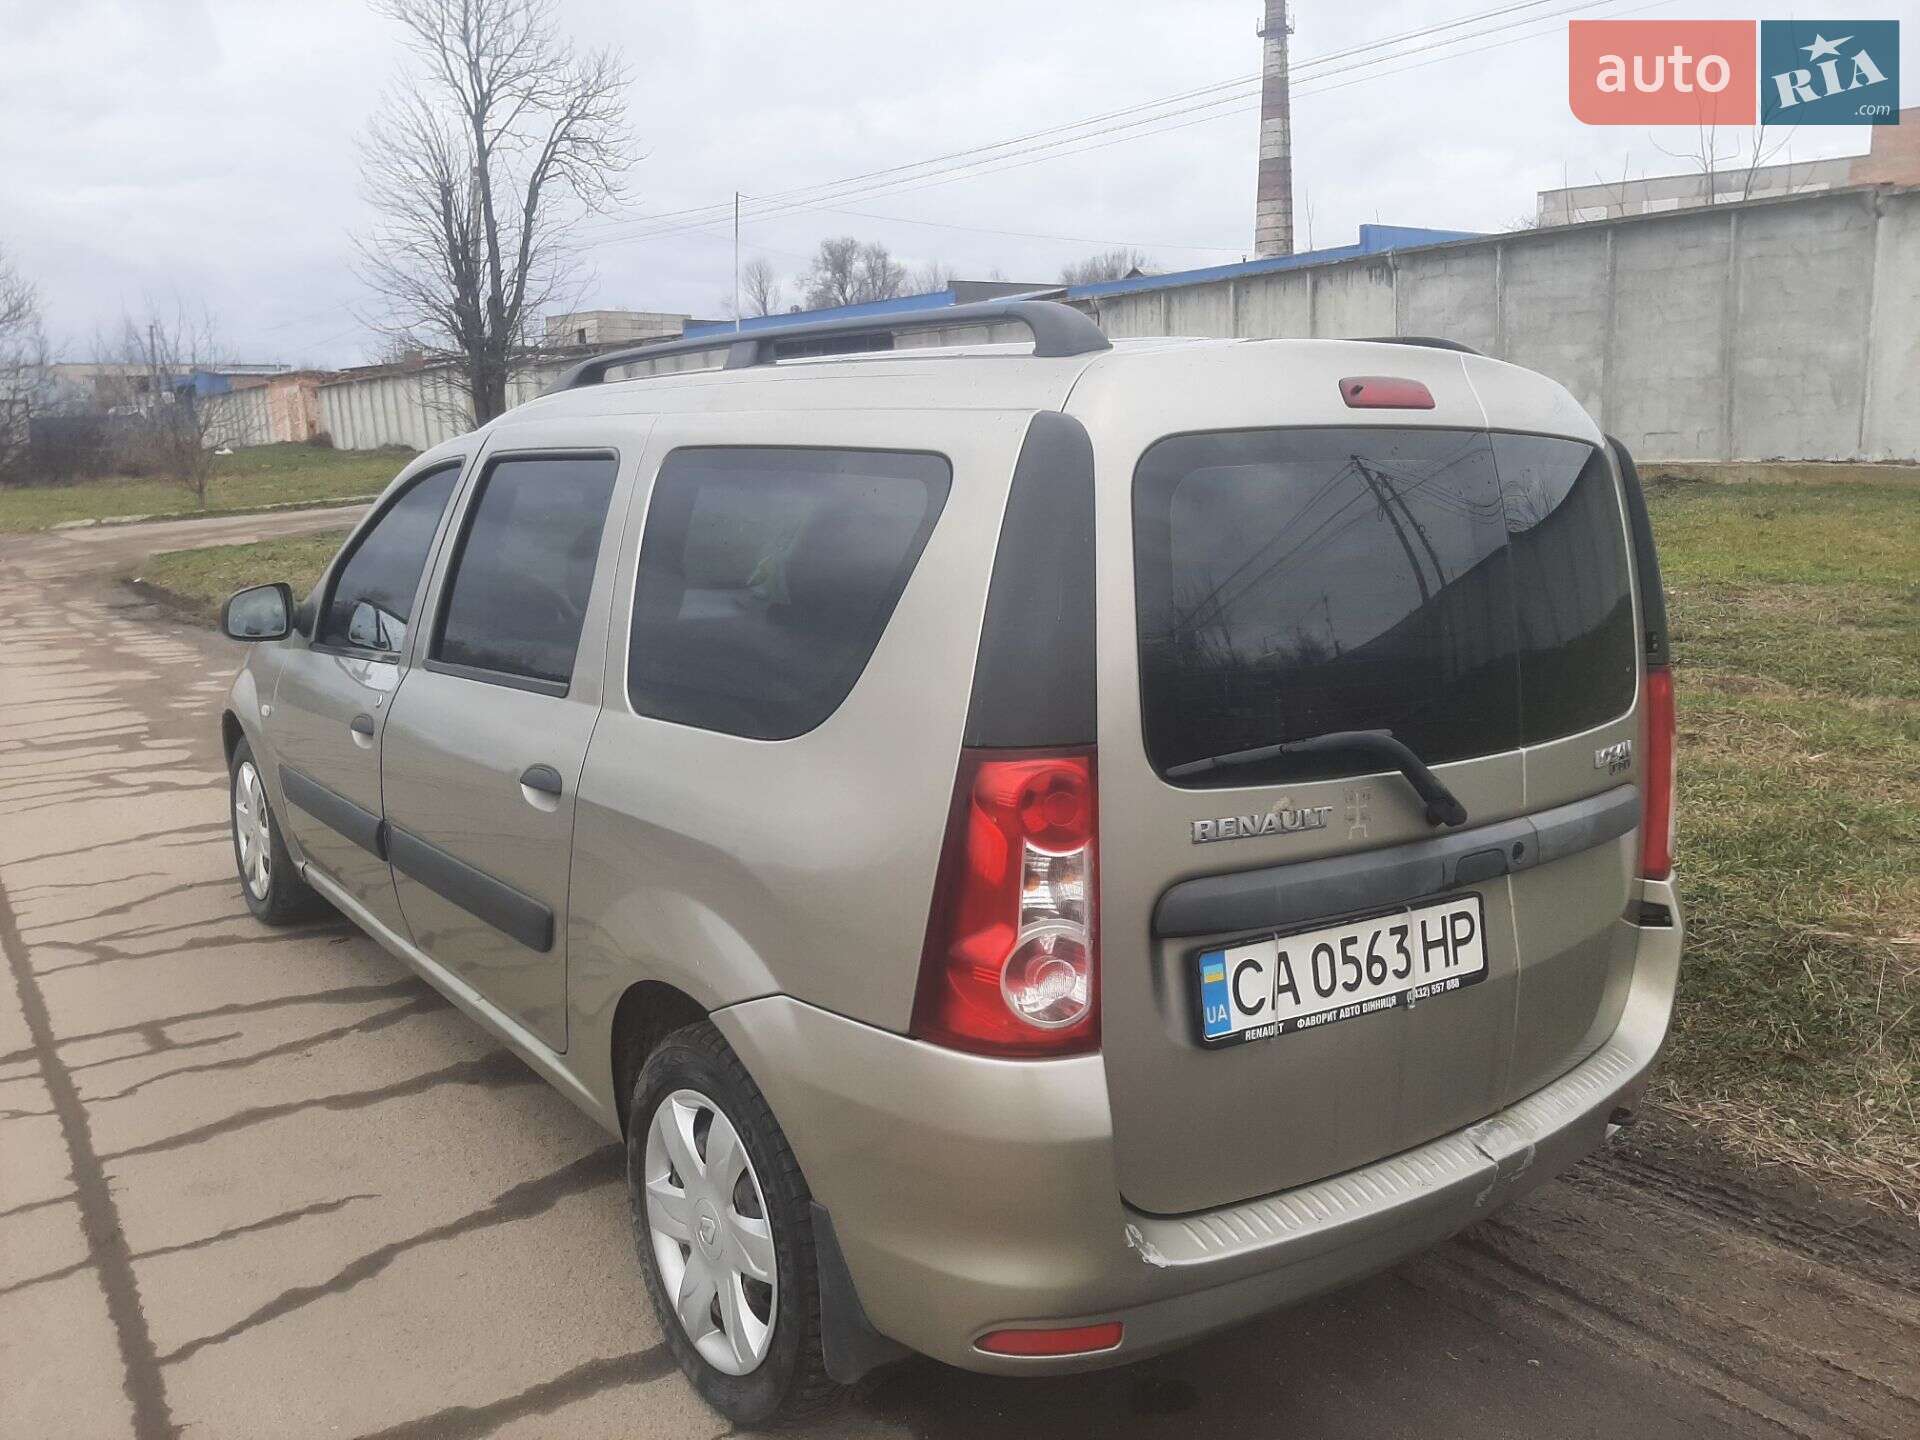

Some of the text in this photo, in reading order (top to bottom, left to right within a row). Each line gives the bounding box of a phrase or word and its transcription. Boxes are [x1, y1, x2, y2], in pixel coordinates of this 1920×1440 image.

[1192, 806, 1333, 844] RENAULT
[1231, 910, 1475, 1016] CA 0563 HP
[1205, 1004, 1229, 1024] UA
[1245, 1023, 1284, 1041] RENAUT
[1297, 1010, 1338, 1029] ФАВОРИТ
[1339, 1002, 1361, 1020] АВТО
